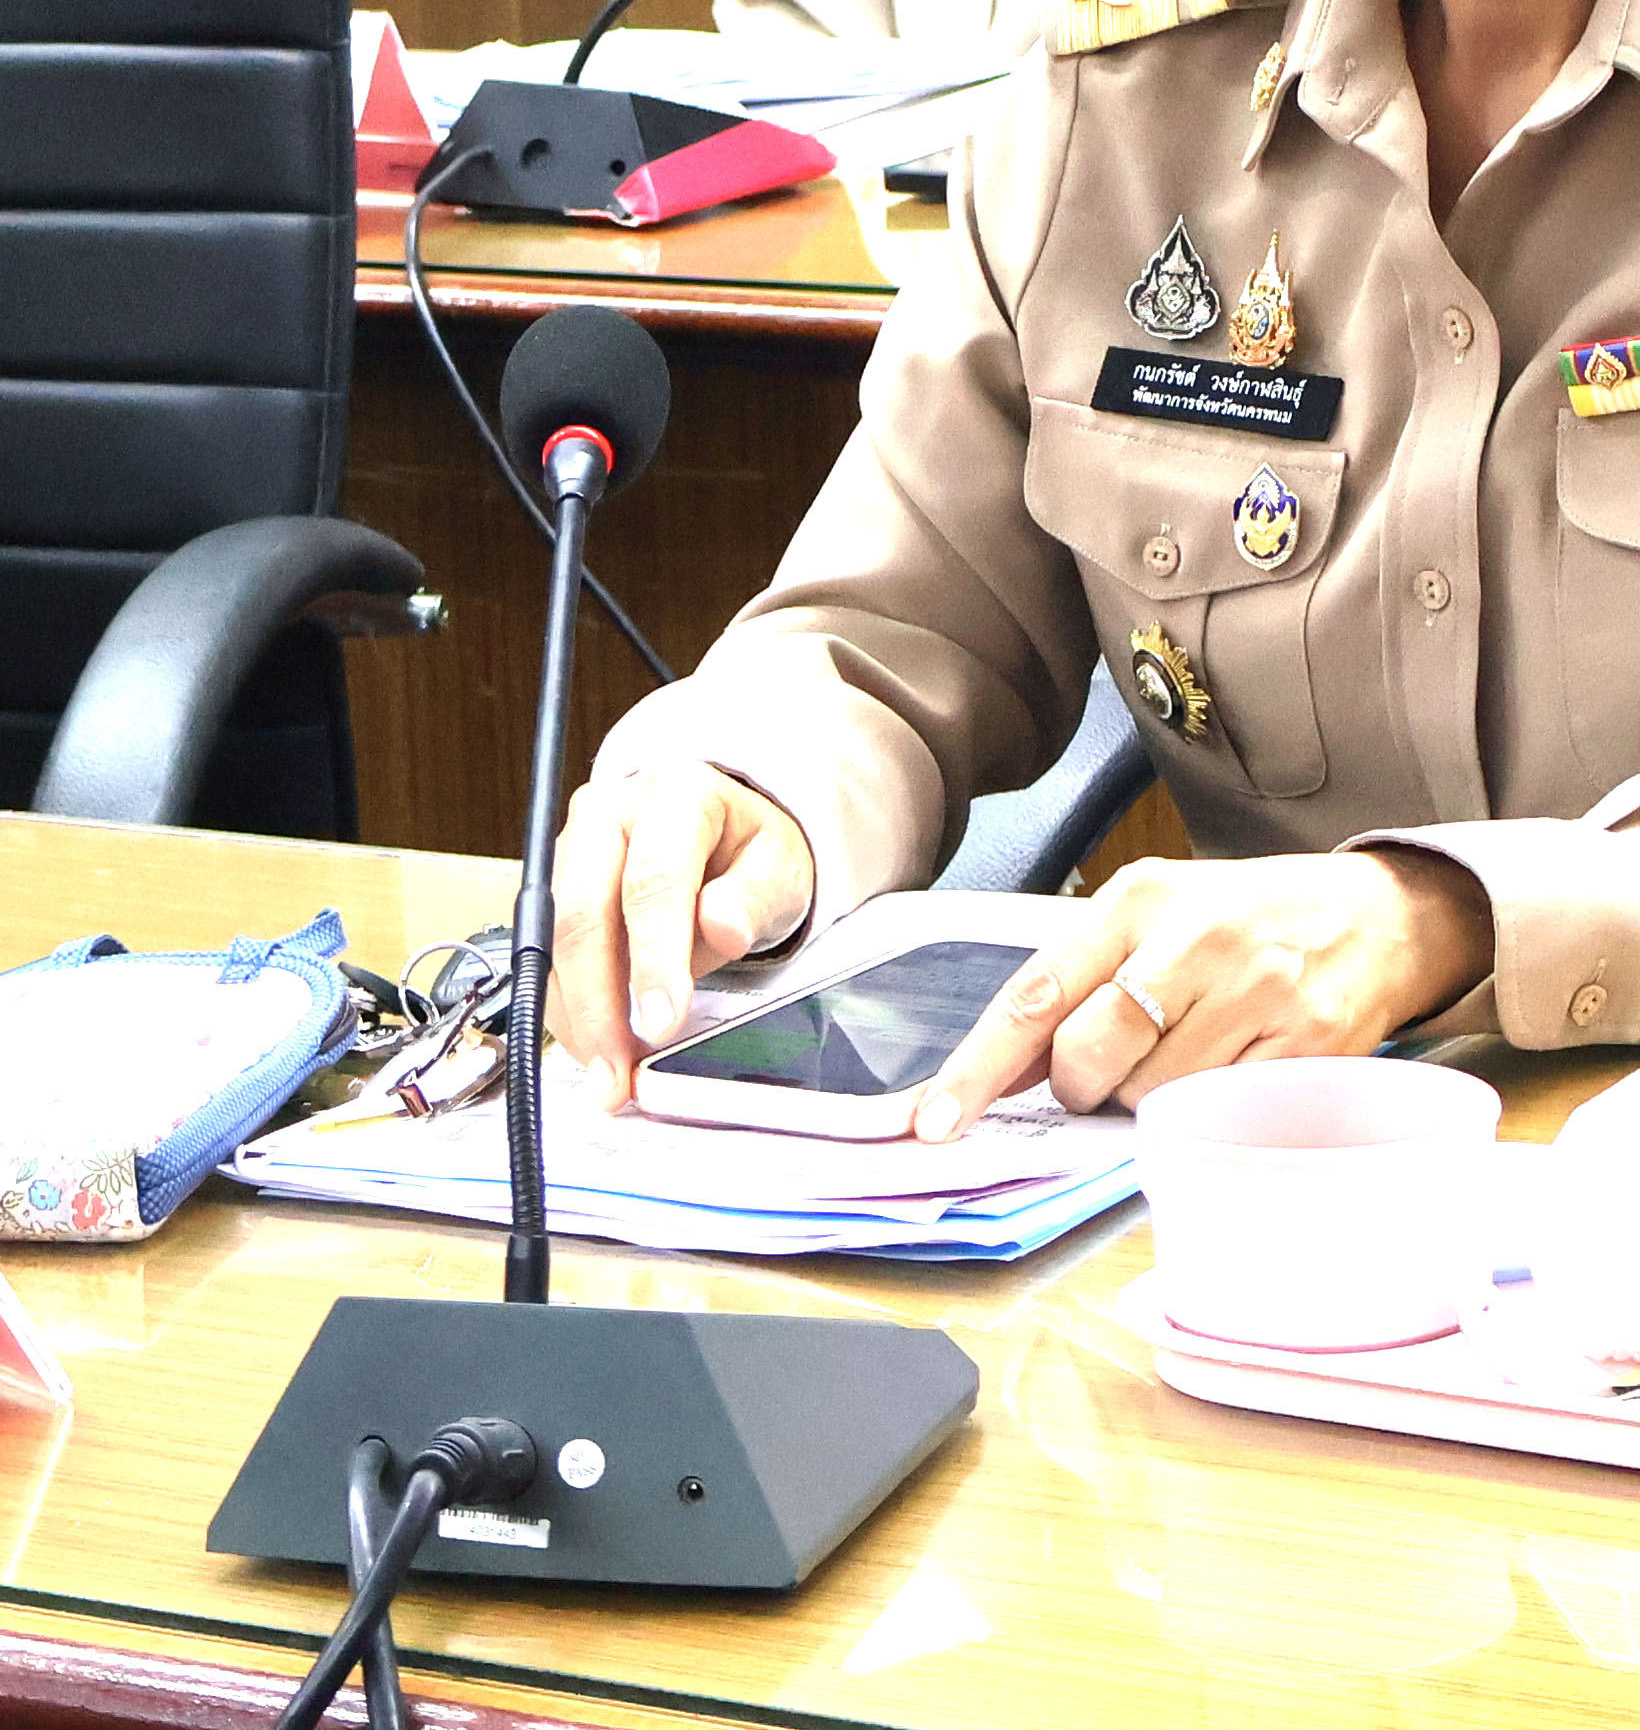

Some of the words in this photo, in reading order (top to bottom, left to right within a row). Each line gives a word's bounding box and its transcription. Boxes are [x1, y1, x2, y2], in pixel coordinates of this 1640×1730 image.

[1132, 385, 1293, 424] พัฒนาการจังหวัดนครพนม
